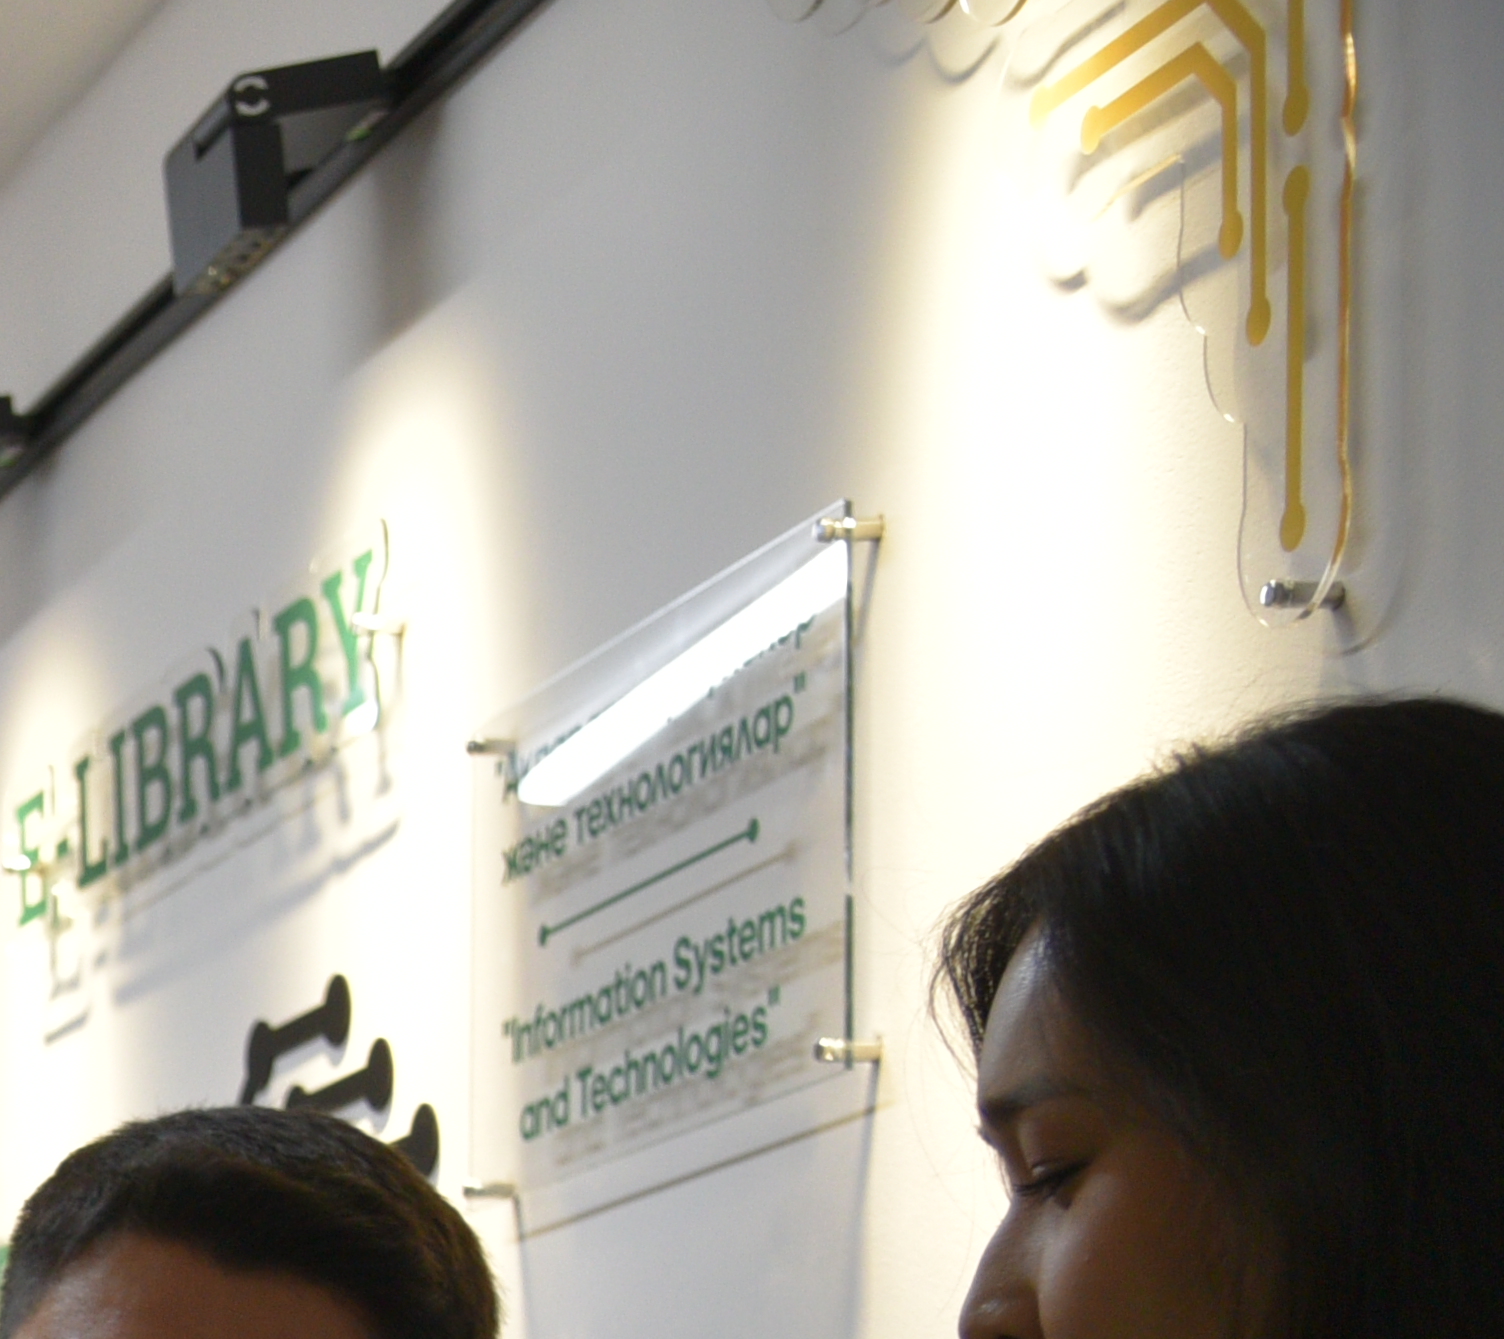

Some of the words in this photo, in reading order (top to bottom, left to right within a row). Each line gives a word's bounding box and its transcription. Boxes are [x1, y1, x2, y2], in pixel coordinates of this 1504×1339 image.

[16, 549, 373, 928] E-LIBRARY
[502, 818, 568, 886] және
[573, 671, 807, 845] технологиялар"
[502, 961, 668, 1064] "Information
[673, 897, 807, 995] Systems
[520, 1075, 571, 1141] and
[576, 985, 781, 1118] Technologies"
